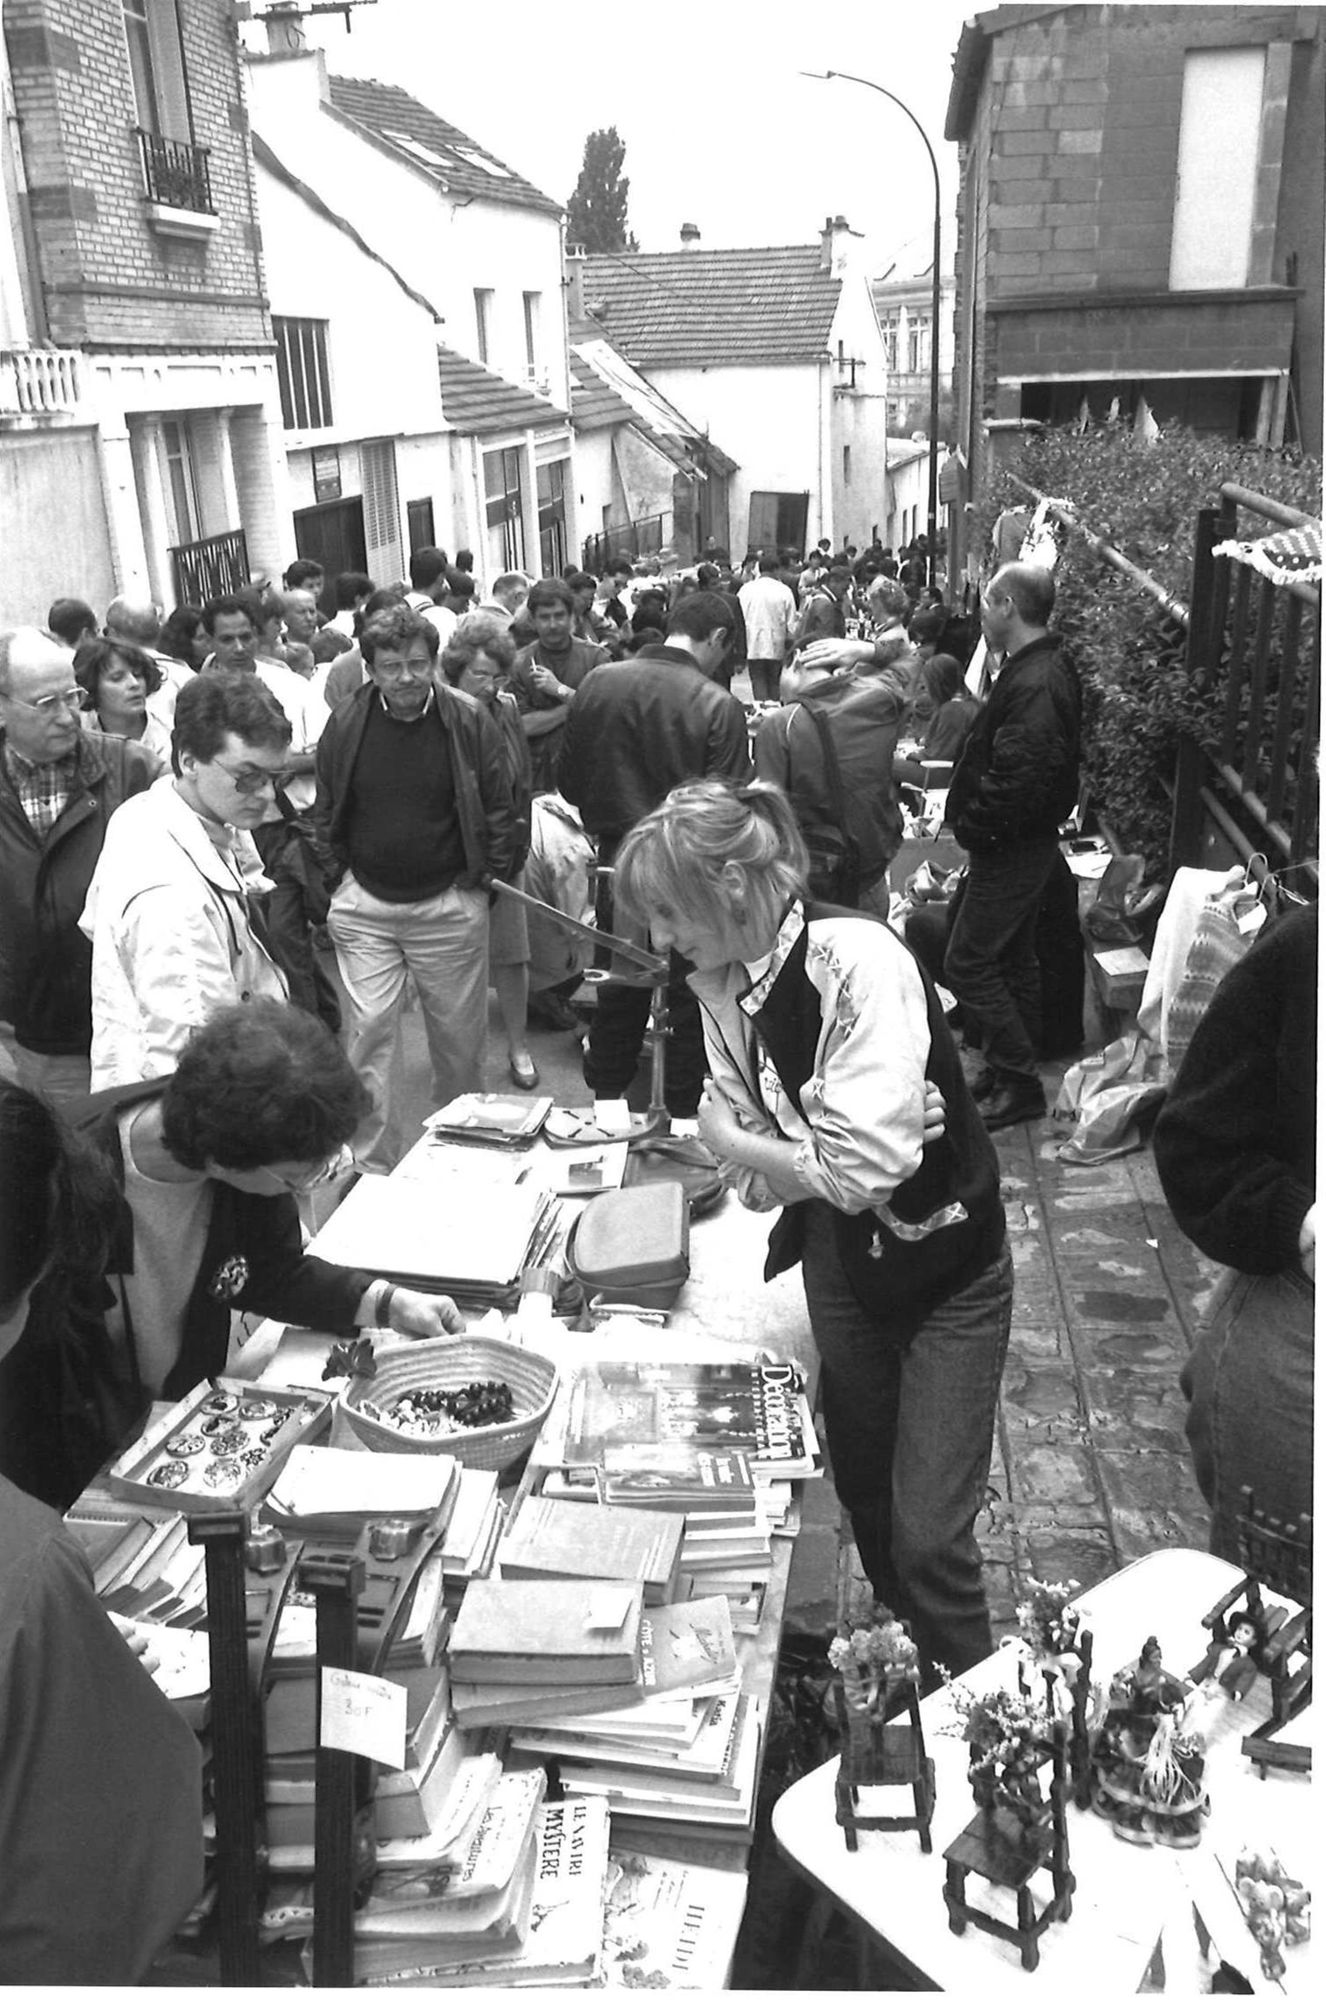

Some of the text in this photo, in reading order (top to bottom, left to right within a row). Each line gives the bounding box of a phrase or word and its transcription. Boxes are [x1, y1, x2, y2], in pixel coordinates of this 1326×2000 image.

[760, 1364, 797, 1460] Décoration
[540, 1808, 567, 1880] MYSTERE
[573, 1805, 587, 1822] LE
[672, 1903, 706, 1970] HEIDI
